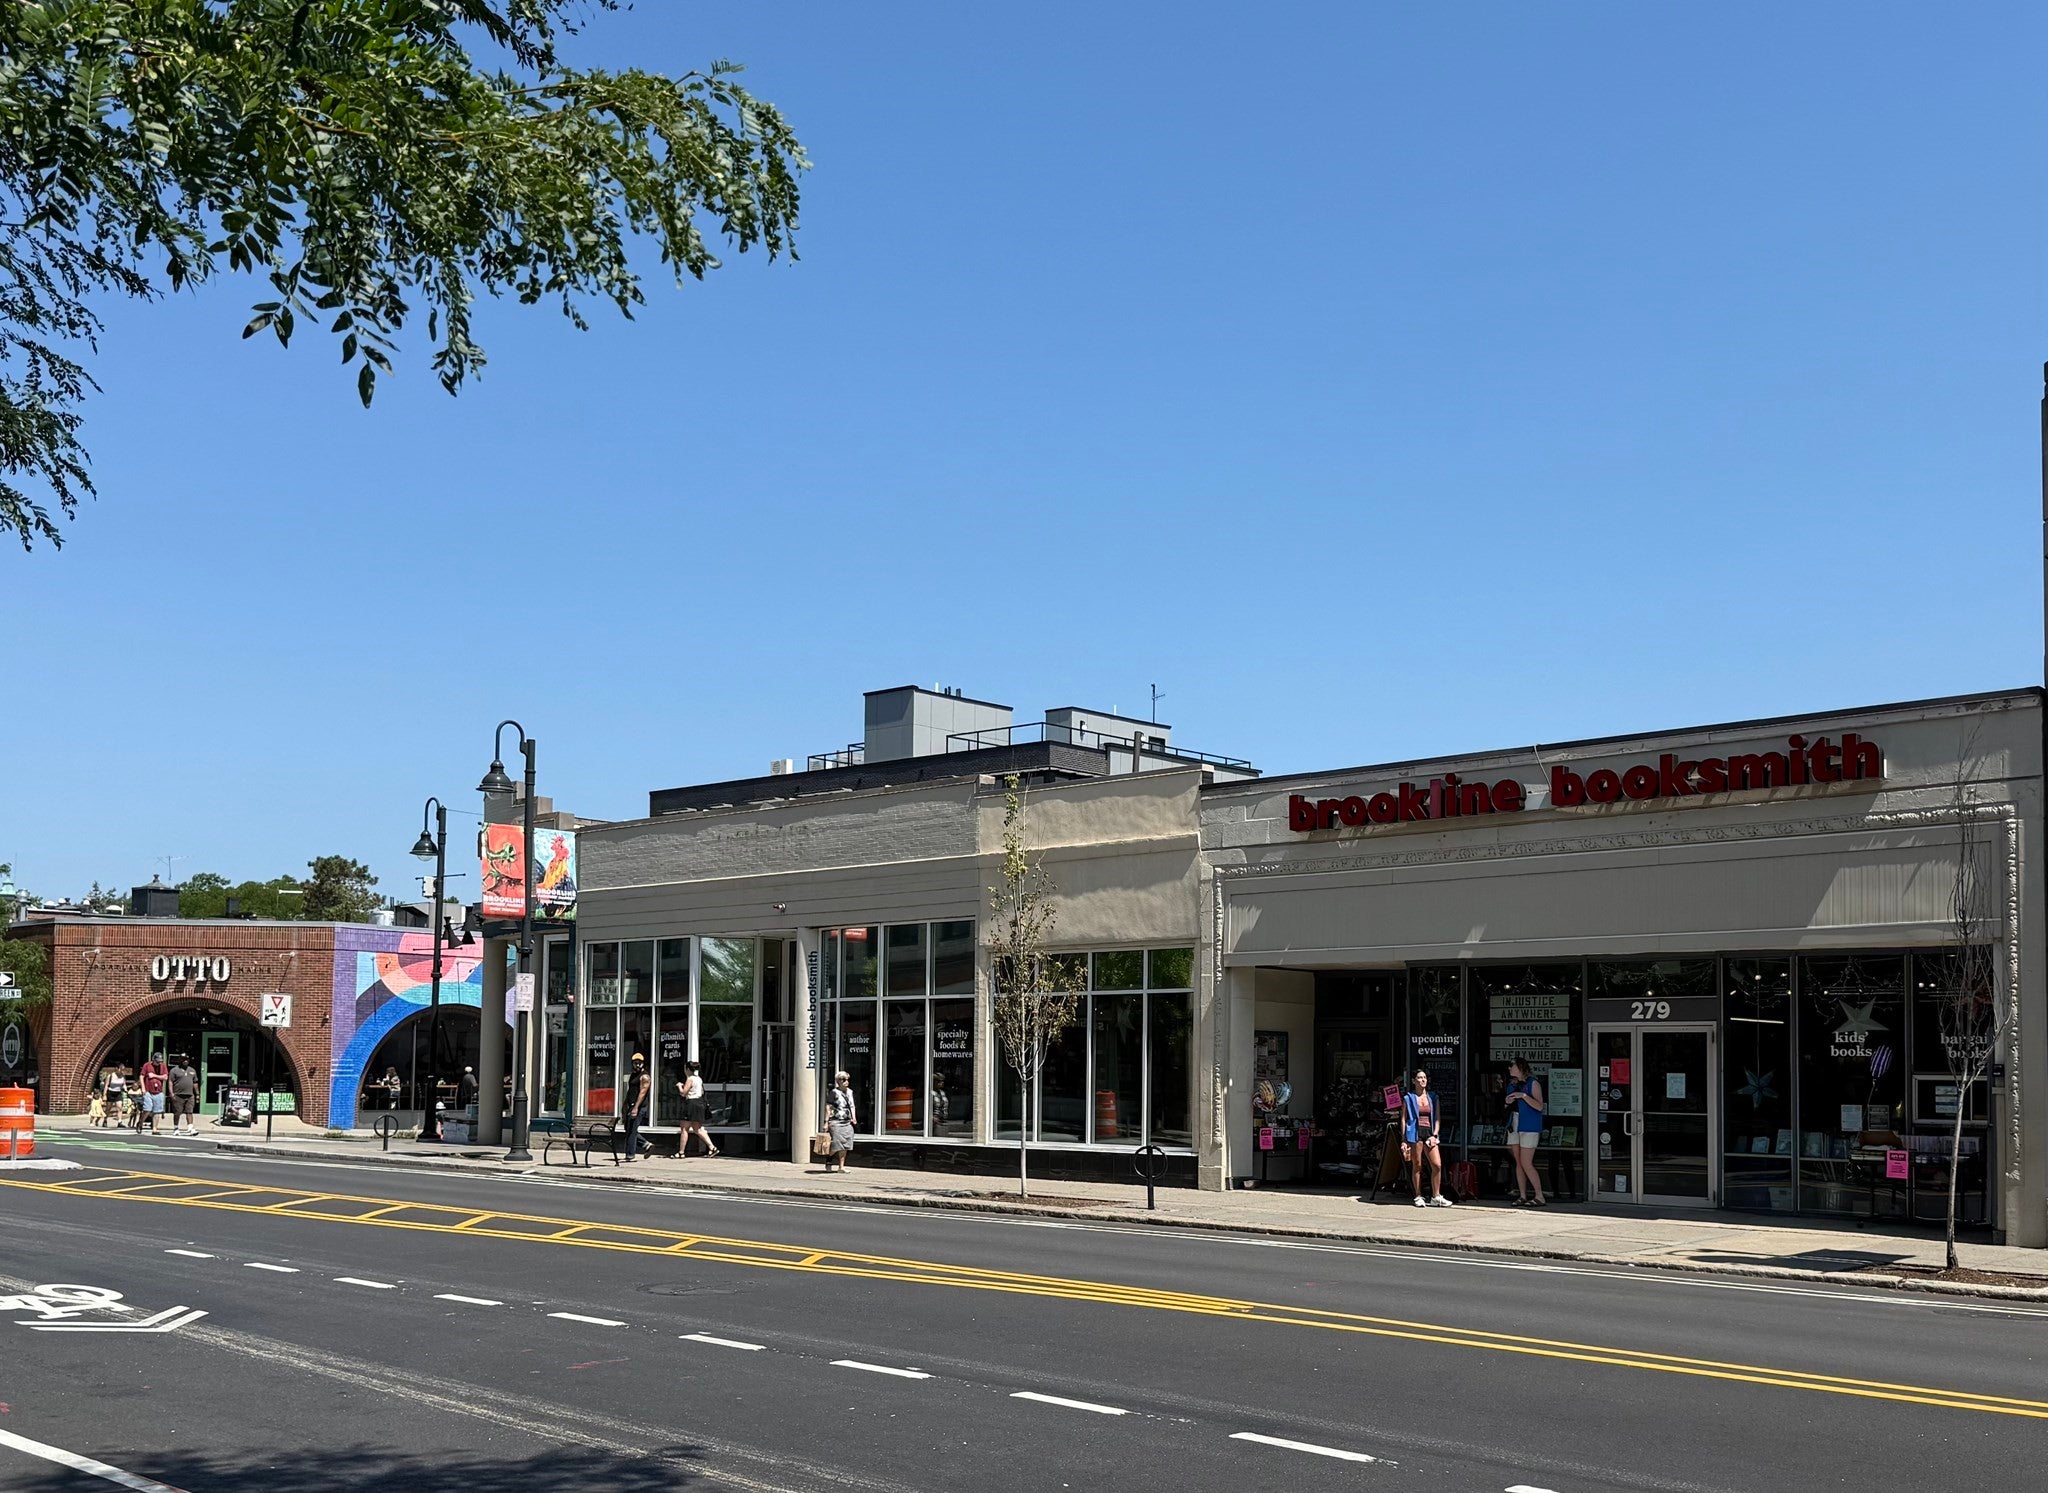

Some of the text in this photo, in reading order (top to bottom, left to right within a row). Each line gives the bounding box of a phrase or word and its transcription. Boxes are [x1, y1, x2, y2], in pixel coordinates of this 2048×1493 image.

[1289, 733, 1884, 832] brookline booksmith
[151, 954, 231, 982] OTTO
[238, 966, 272, 974] MAINE
[1503, 996, 1555, 1006] INJUSTICE
[805, 951, 818, 1069] brookline booksmith
[1501, 1009, 1556, 1018] ANYWHERE
[1631, 1001, 1671, 1019] 279
[660, 1033, 685, 1042] giftsmith
[849, 1035, 870, 1043] author
[937, 1029, 968, 1039] specialty
[1411, 1033, 1460, 1045] upcoming
[1834, 1031, 1869, 1043] kids'
[939, 1040, 966, 1049] foods &
[1508, 1038, 1550, 1047] JUSTICE
[1940, 1032, 1987, 1047] bargai
[588, 1041, 616, 1050] noteworthy
[664, 1041, 680, 1049] cards
[849, 1045, 869, 1053] events
[1418, 1045, 1453, 1055] events
[594, 1049, 609, 1057] books
[669, 1049, 681, 1059] gifts
[933, 1049, 973, 1058] homewares
[1495, 1050, 1563, 1060] EVERYWHERE
[1830, 1045, 1872, 1057] books
[1947, 1046, 1985, 1058] book
